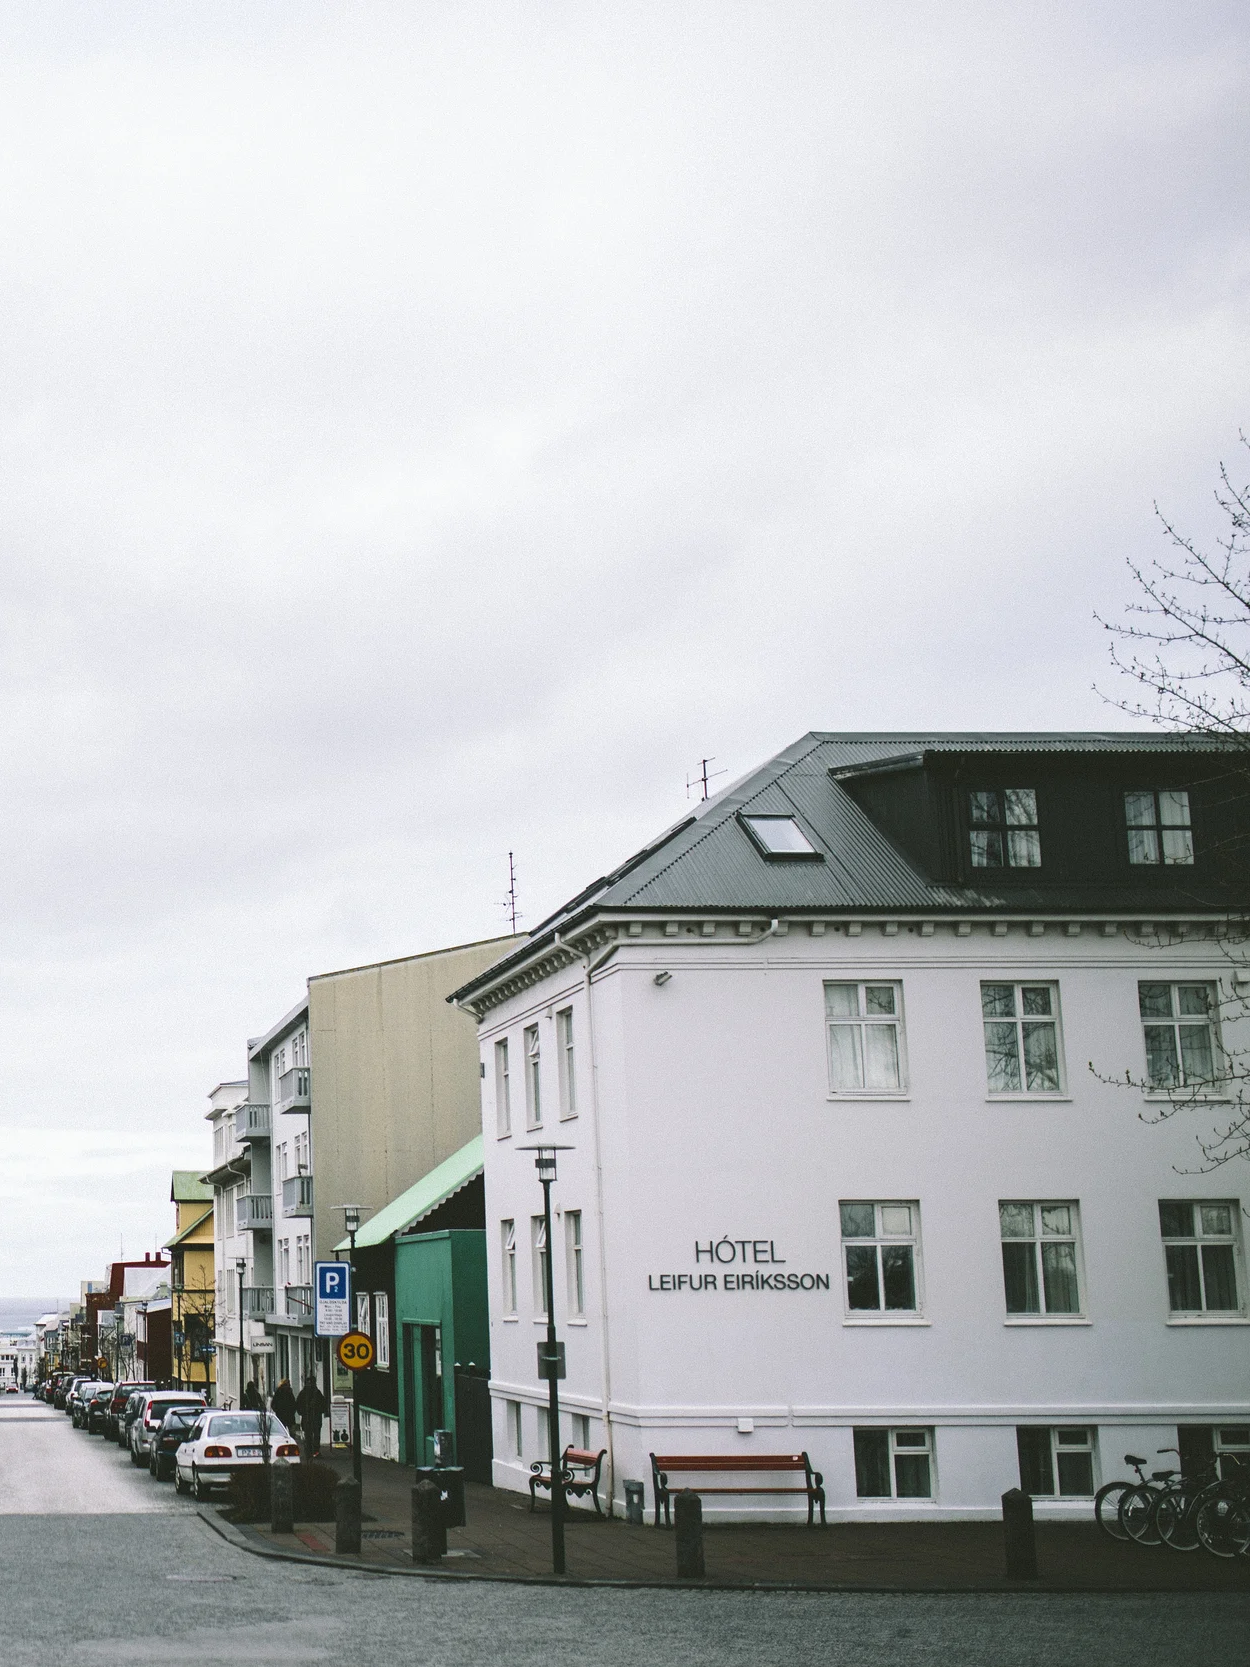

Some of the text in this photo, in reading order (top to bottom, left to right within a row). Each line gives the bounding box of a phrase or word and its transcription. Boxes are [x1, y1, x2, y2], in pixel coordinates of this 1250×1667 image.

[695, 1235, 786, 1264] HÓTEL
[325, 1272, 340, 1293] P
[649, 1270, 830, 1291] LEIFUR EIRÍKSSON
[343, 1343, 370, 1360] 30
